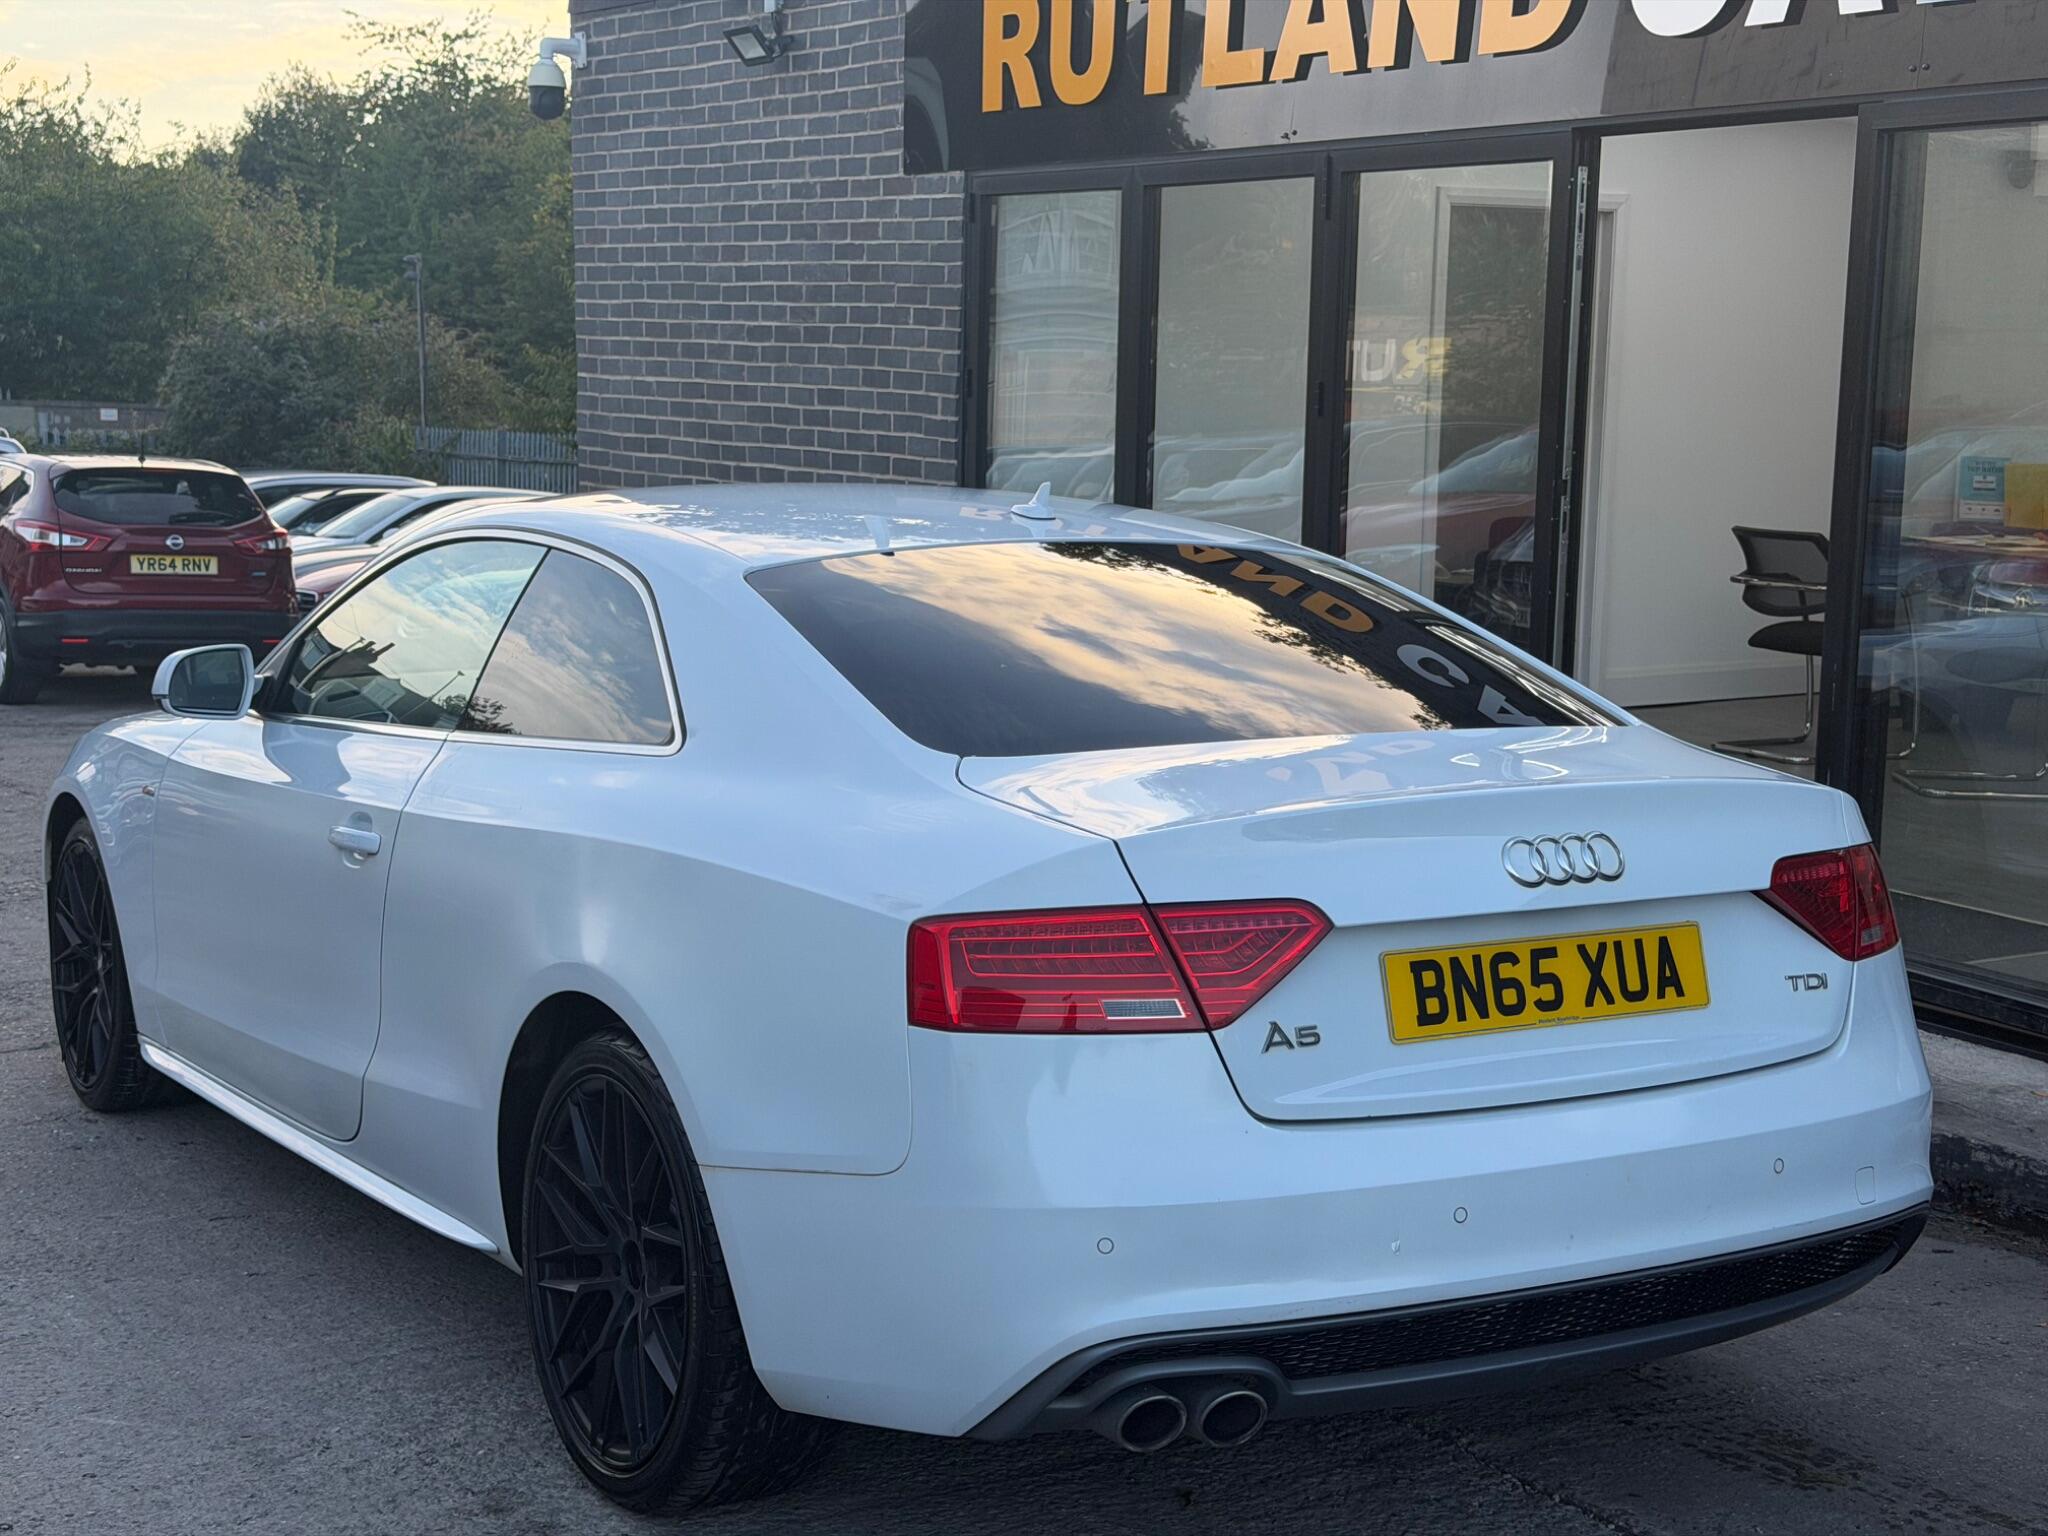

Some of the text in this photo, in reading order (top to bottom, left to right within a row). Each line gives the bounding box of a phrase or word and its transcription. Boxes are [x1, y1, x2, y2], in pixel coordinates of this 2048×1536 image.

[136, 557, 211, 572] YR64 RNV
[1409, 936, 1686, 1027] BN65 XUA
[1784, 972, 1828, 992] TDI
[1261, 1021, 1320, 1054] A5
